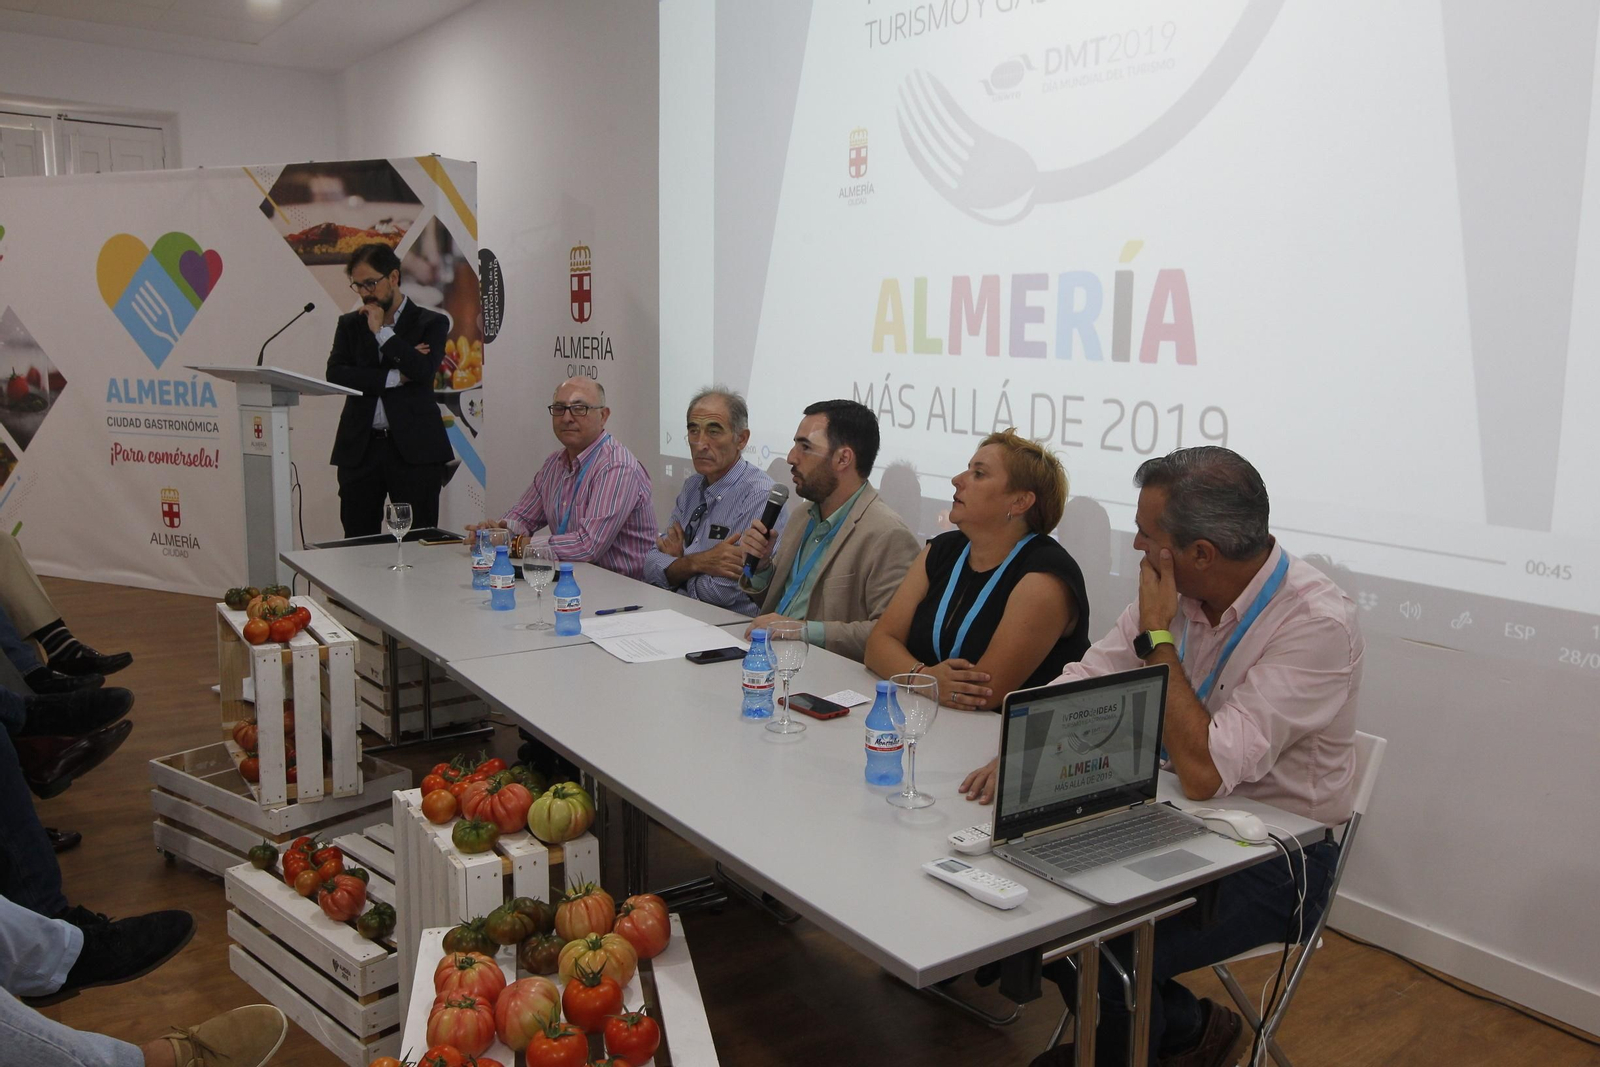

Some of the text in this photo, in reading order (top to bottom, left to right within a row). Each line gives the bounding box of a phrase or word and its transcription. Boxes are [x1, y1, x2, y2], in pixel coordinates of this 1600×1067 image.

[865, 0, 968, 48] TURISMO
[1126, 57, 1176, 77] TURISMO
[838, 181, 875, 198] ALMERÍA
[871, 239, 1198, 366] ALMERÍA
[554, 331, 614, 361] ALMERÍA
[567, 364, 598, 380] CIUDAD
[106, 374, 217, 408] ALMERÍA
[107, 416, 220, 433] CIUDAD GASTRONÓMICA
[926, 378, 1015, 437] ALLÁ
[1030, 392, 1084, 448] DE
[1100, 398, 1229, 455] 2019
[110, 442, 219, 469] ¡Para comérsela!
[150, 532, 200, 550] ALMERÍA
[162, 547, 189, 558] CIUDAD
[1525, 559, 1572, 580] 00:45
[1504, 622, 1536, 640] ESP
[1060, 753, 1109, 780] ALMERÍA
[1086, 775, 1095, 785] DE
[1096, 771, 1113, 783] 2019
